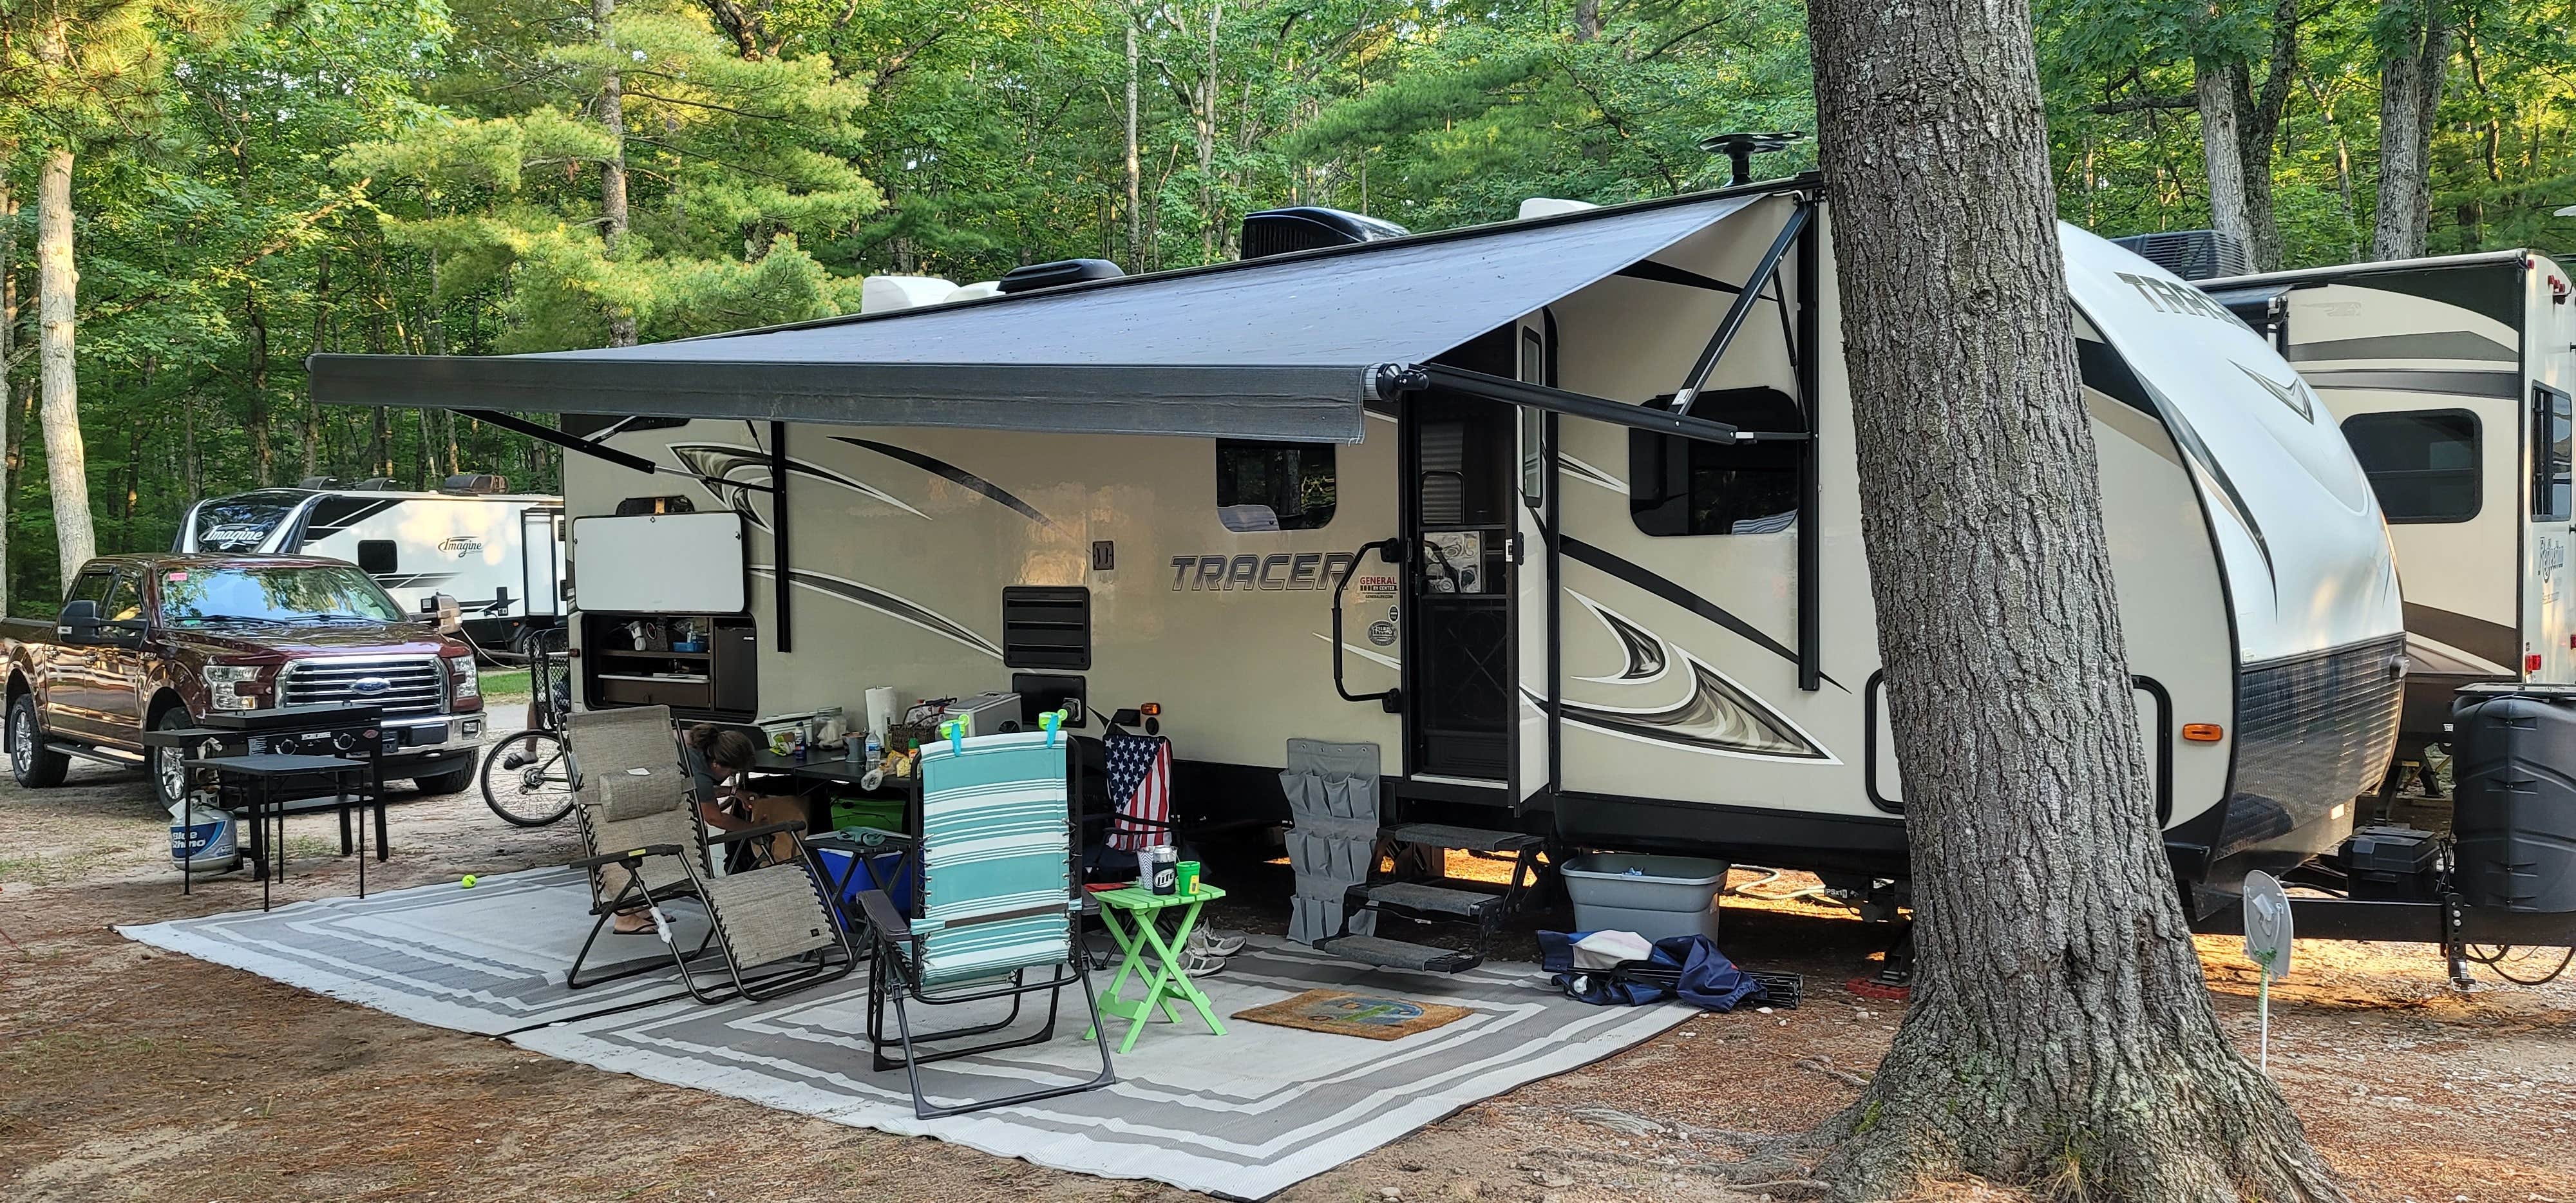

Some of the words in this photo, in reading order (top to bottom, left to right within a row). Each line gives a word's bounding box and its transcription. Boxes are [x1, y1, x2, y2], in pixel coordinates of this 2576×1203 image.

[202, 525, 265, 549] Imagine
[442, 537, 483, 558] Imagine
[1170, 553, 1356, 591] TRACER
[1359, 576, 1397, 585] GENERAL
